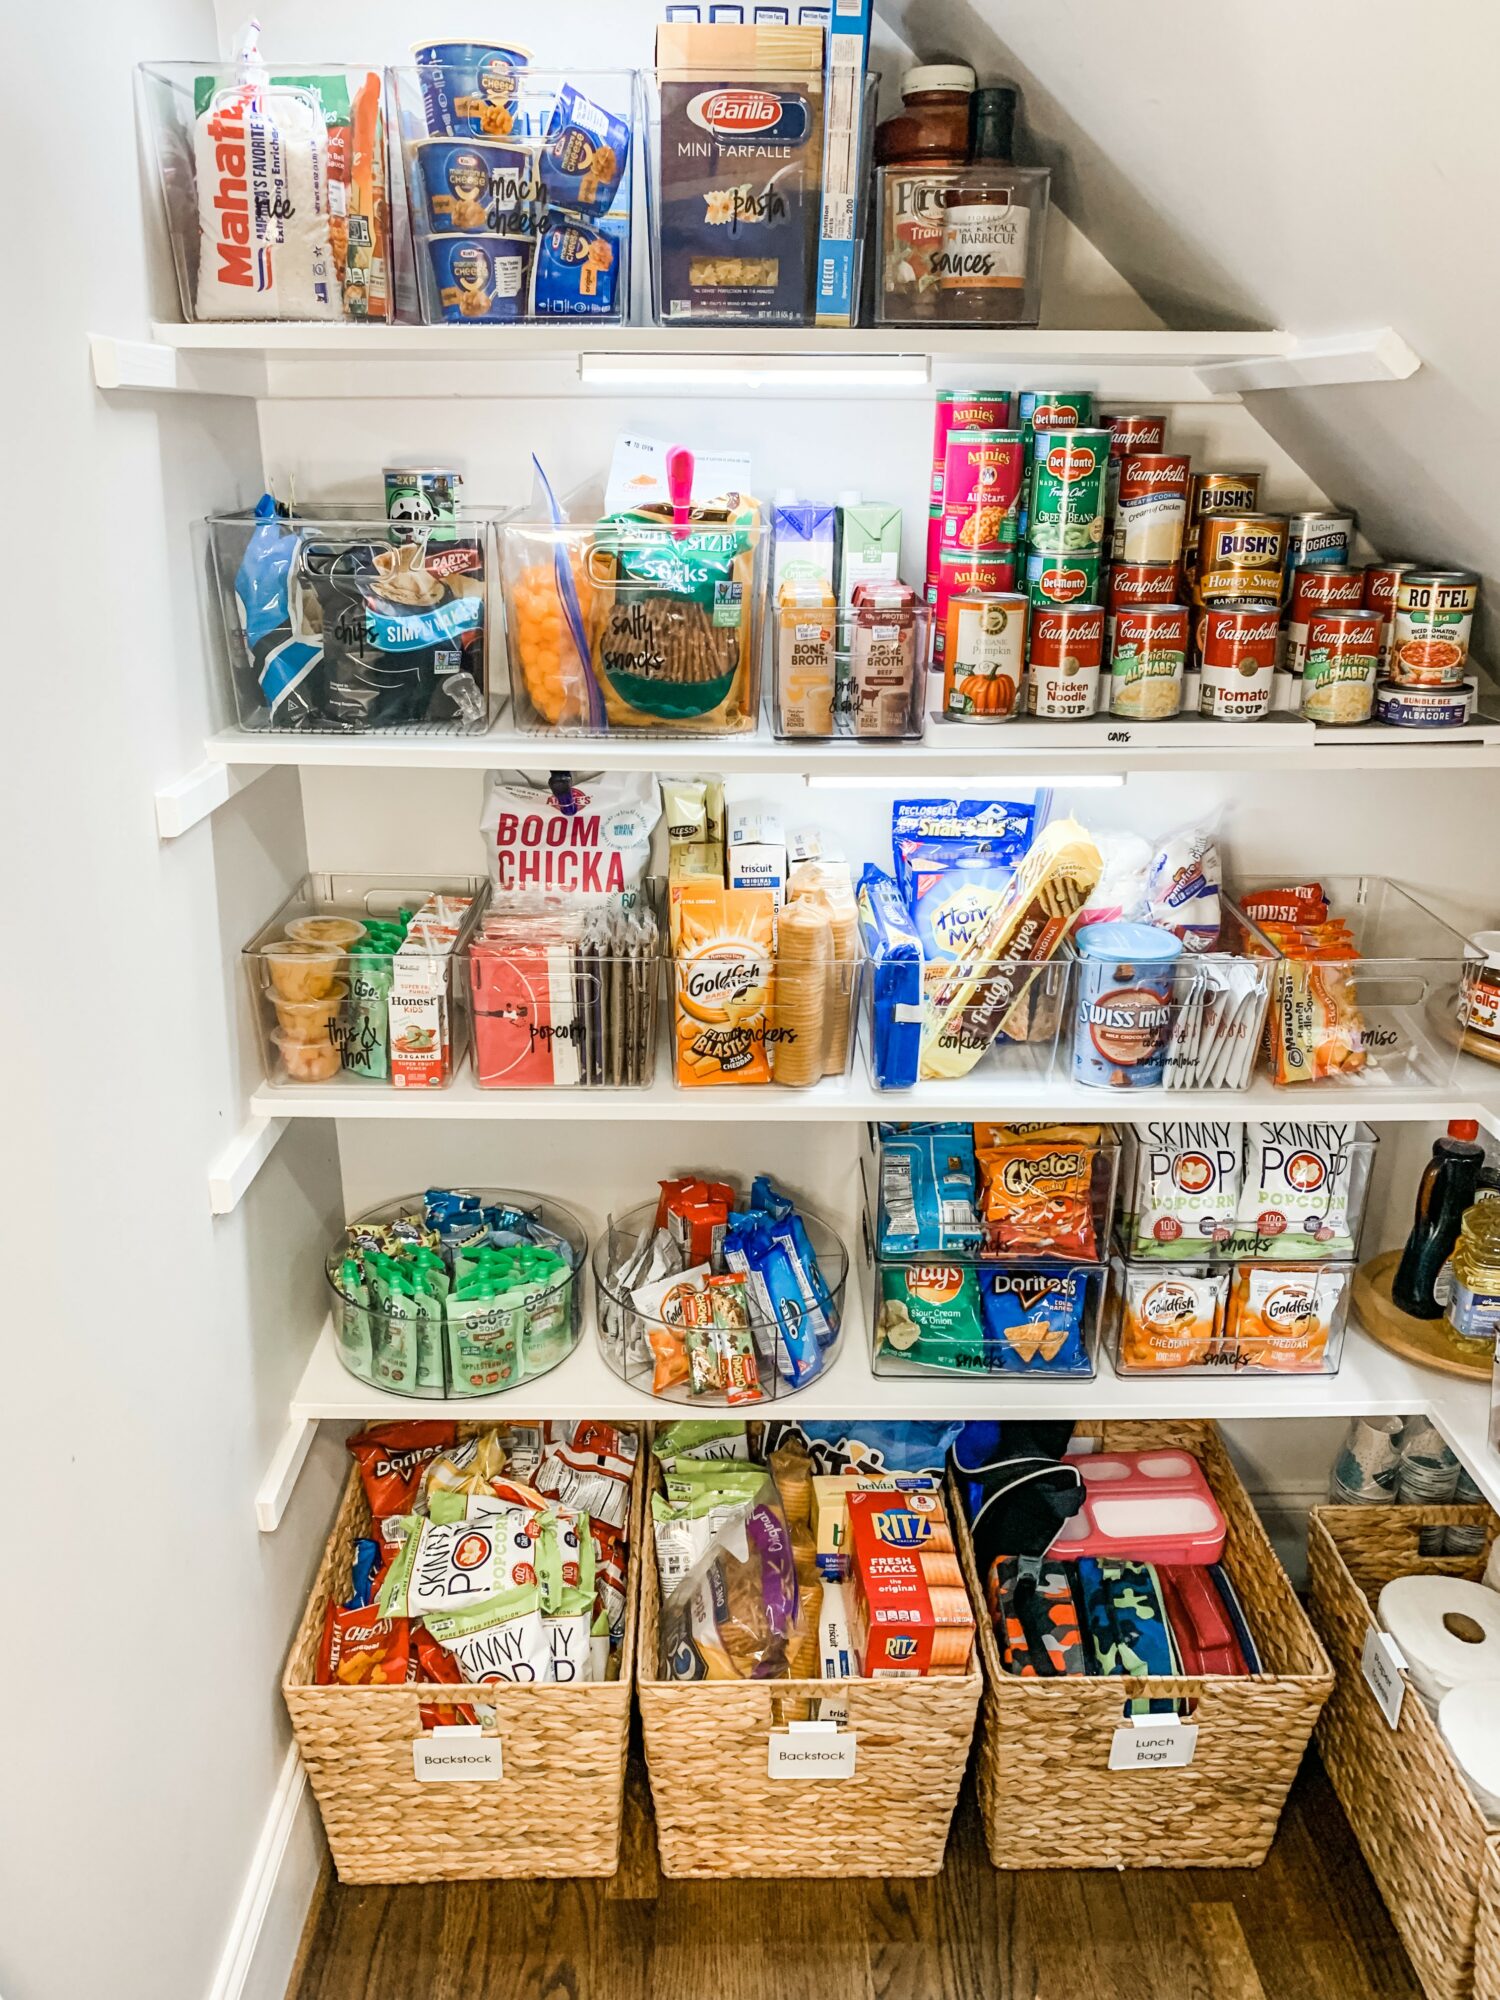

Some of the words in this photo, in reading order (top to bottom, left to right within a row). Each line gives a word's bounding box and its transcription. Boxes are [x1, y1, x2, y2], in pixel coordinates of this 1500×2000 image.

[710, 100, 775, 120] Barilla
[250, 123, 266, 177] FAVORITE
[678, 142, 711, 157] MINI
[719, 143, 791, 159] FARFALLE
[733, 183, 786, 234] pasta
[846, 199, 854, 214] 200
[487, 198, 553, 235] cheese
[960, 232, 1016, 245] BARBECUE
[929, 250, 995, 276] sauces
[952, 406, 994, 422] Annie's
[1035, 414, 1050, 424] Del
[1050, 414, 1076, 424] Monte
[968, 448, 1011, 465] Annie's
[1050, 457, 1063, 467] Del
[1065, 457, 1093, 467] Monte
[1126, 462, 1185, 485] Campbell's
[1057, 502, 1078, 512] CUT
[1126, 499, 1145, 507] GREAT
[1153, 493, 1181, 501] COOKING
[1158, 503, 1181, 512] Chicken
[1201, 490, 1254, 510] BUSH'S
[1038, 511, 1067, 522] GREEN
[1068, 512, 1094, 523] BEANS
[1311, 523, 1335, 532] LIGHT
[1221, 535, 1279, 555] BUSH'S
[1294, 533, 1344, 552] PROGRESSO
[432, 552, 471, 570] PARTY
[954, 569, 997, 585] Annie's
[1043, 577, 1057, 588] Del
[1060, 578, 1085, 588] Monte
[1114, 573, 1174, 597] Campbell's
[1208, 575, 1249, 589] Honey
[1250, 574, 1280, 588] Sweet
[1300, 579, 1361, 602] Campbell's
[1214, 597, 1245, 605] BAKED
[1424, 614, 1450, 622] Mild
[334, 614, 379, 658] chips
[387, 618, 433, 644] SIMPLY
[612, 605, 655, 651] salty
[1039, 620, 1100, 645] Campbell's
[1120, 620, 1182, 642] Campbell's
[1215, 620, 1277, 644] Campbell's
[1312, 624, 1375, 647] Campbell's
[604, 639, 666, 676] snacks
[794, 644, 825, 655] BONE
[972, 646, 1011, 656] Pumpkin
[1118, 649, 1135, 660] Kids
[1138, 649, 1176, 665] Chicken
[791, 656, 828, 666] BROTH
[867, 656, 904, 666] BROTH
[1329, 654, 1369, 668] Chicken
[1125, 662, 1177, 685] ALPHABET
[1315, 666, 1370, 689] ALPHABET
[1046, 681, 1089, 692] Chicken
[1217, 687, 1269, 702] Tomato
[1047, 691, 1087, 701] Noodle
[1047, 705, 1085, 714] SOUP
[1224, 705, 1262, 714] SOUP
[1402, 711, 1450, 720] ALBACORE
[1108, 730, 1131, 742] cans
[899, 802, 958, 816] RECLOSEABLE
[497, 813, 601, 847] BOOM
[498, 850, 625, 893] CHICKA
[741, 864, 772, 873] triscuit
[621, 893, 637, 908] 60
[1247, 906, 1298, 923] HOUSE
[1034, 925, 1059, 961] ORIGINAL
[690, 964, 760, 996] Goldfish
[971, 975, 1013, 1025] Fudge
[998, 919, 1038, 976] Stripes
[392, 997, 436, 1006] Honest
[1285, 975, 1293, 1052] Maruchan
[323, 1016, 360, 1045] this
[361, 1016, 382, 1050] &
[529, 1022, 587, 1054] popcorn
[731, 1017, 798, 1047] crackers
[938, 1026, 991, 1054] cookies
[1360, 1025, 1398, 1046] misc
[336, 1041, 374, 1070] that
[723, 1053, 753, 1070] CHEDDAR
[1137, 1053, 1200, 1069] marshmallows
[1148, 1122, 1231, 1149] SKINNY
[1259, 1121, 1347, 1151] SKINNY
[1003, 1152, 1086, 1195] Cheetos
[1149, 1150, 1236, 1196] POP
[1259, 1147, 1348, 1197] POP
[1150, 1193, 1235, 1210] POPCORN
[1258, 1191, 1346, 1210] POPCORN
[1160, 1220, 1177, 1231] 100
[1220, 1228, 1273, 1257] snacks
[995, 1275, 1076, 1296] Doritos
[934, 1309, 961, 1319] Cream
[1269, 1298, 1320, 1318] Goldfish
[780, 1297, 798, 1340] OREO
[929, 1317, 953, 1325] Onion
[1202, 1345, 1251, 1373] snacks
[376, 1445, 444, 1477] Doritos
[857, 1481, 894, 1491] belVita
[917, 1497, 927, 1505] 8
[871, 1512, 934, 1540] RITZ
[493, 1515, 508, 1592] POPCORN
[871, 1557, 912, 1565] FRESH
[515, 1567, 526, 1584] 100
[563, 1566, 573, 1579] 100
[869, 1565, 917, 1573] STACKS
[878, 1585, 917, 1594] original
[439, 1631, 456, 1640] PURE
[828, 1624, 838, 1648] triscuit
[885, 1638, 918, 1655] RITZ
[1135, 1738, 1175, 1749] Lunch
[424, 1754, 493, 1765] Backstock
[779, 1751, 846, 1761] Backstock
[1136, 1751, 1168, 1762] Bags
